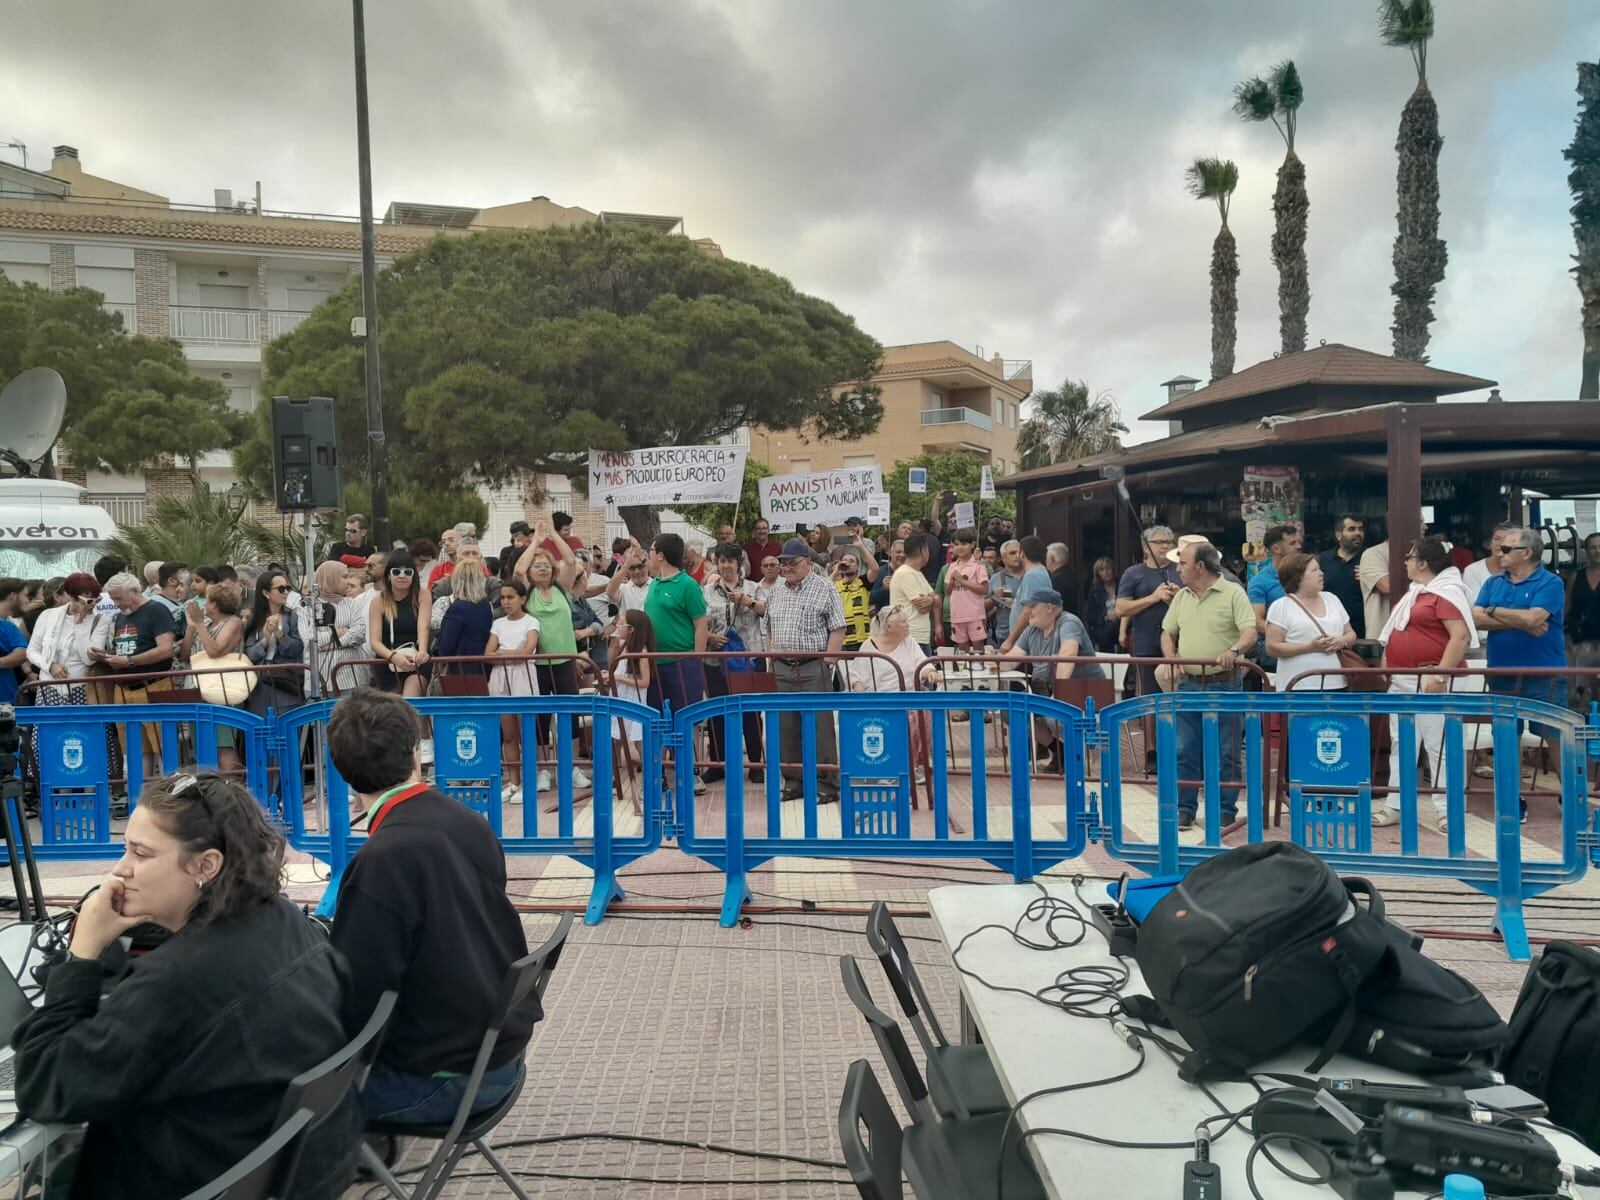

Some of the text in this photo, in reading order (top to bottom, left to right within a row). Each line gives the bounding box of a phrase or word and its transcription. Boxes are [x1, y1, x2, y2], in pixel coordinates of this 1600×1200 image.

[597, 449, 725, 468] MENOS BURROCRACIA
[592, 466, 726, 486] Y MÁS PRODUCTO EUROPEO
[849, 473, 858, 488] PA
[861, 471, 873, 485] LOS
[770, 496, 819, 514] PAYESES
[0, 526, 99, 539] veron
